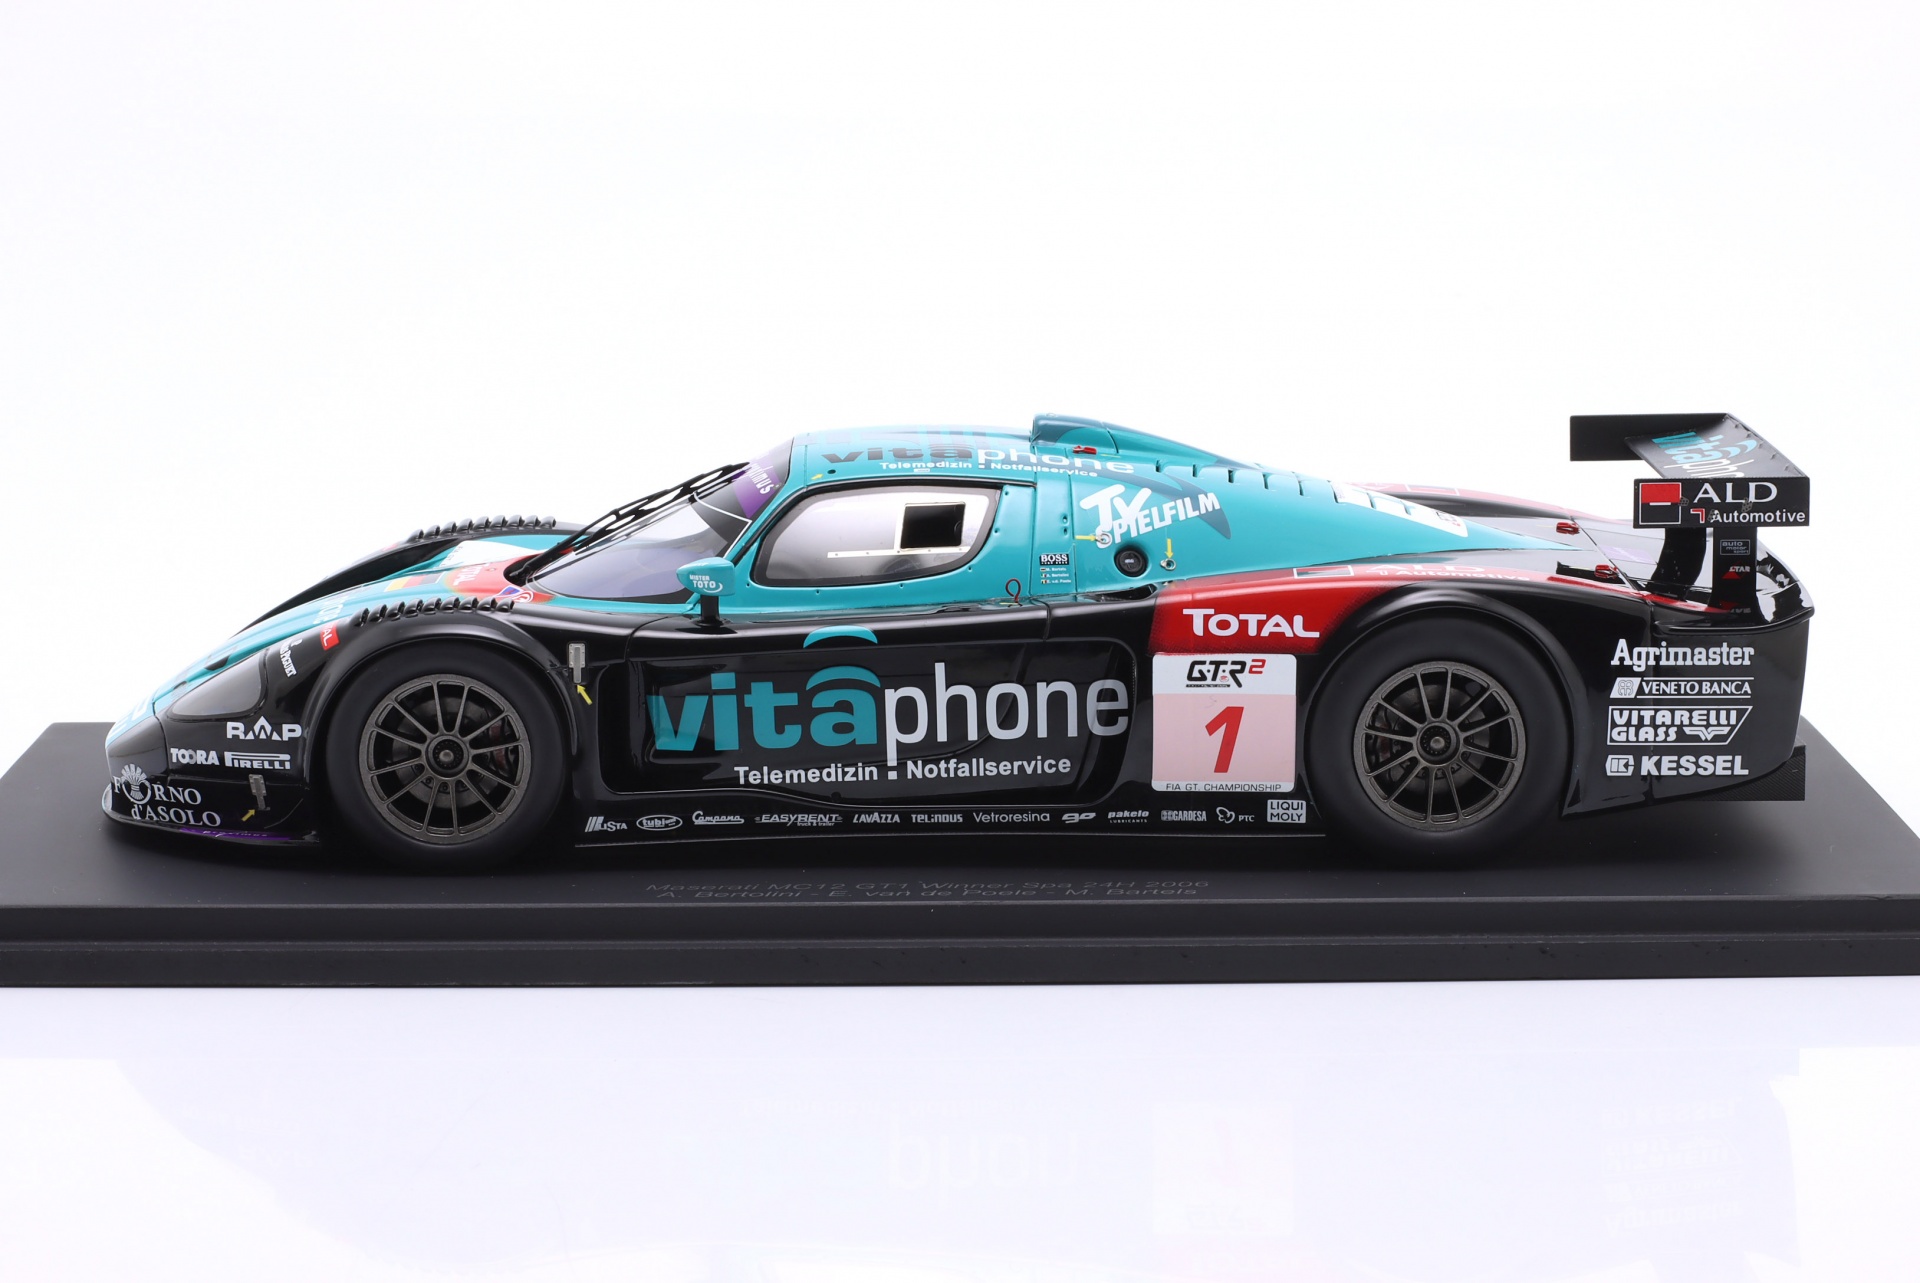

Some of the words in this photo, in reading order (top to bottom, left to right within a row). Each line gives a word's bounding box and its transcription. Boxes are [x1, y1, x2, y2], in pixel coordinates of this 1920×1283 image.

[821, 446, 1134, 474] vitaphone
[879, 461, 972, 470] Telemedizin
[990, 462, 1098, 477] Notfallservice
[1693, 481, 1777, 503] ALD
[1712, 508, 1806, 523] Automotive
[1041, 554, 1068, 562] BOSS
[693, 580, 716, 588] TOTO
[1182, 608, 1320, 638] TOTAL
[1610, 638, 1755, 672] Agrimaster
[1641, 681, 1699, 694] VENETO
[1701, 681, 1752, 694] BANCA
[646, 662, 1129, 767] vitaphone
[1612, 709, 1737, 725] VITARELLI
[1205, 706, 1245, 773] 1
[1611, 726, 1678, 742] GLASS
[170, 748, 219, 766] TOORA
[223, 751, 291, 769] PIRELLI
[734, 763, 878, 785] Telemedizin
[906, 755, 1071, 779] Notfallservice
[1640, 755, 1749, 776] KESSEL
[1165, 783, 1181, 791] FIA
[1203, 783, 1282, 791] CHAMPIONSHIP
[1270, 800, 1303, 811] LIQUI
[131, 804, 222, 827] d'ASOLO
[760, 814, 840, 826] EASYRENT
[852, 812, 900, 823] LAVAZZA
[973, 811, 1050, 823] Vetroresina
[1107, 810, 1149, 819] pakelo
[1173, 810, 1207, 821] GARDESA
[1270, 812, 1303, 822] MOLY
[645, 883, 760, 891] Maserati
[767, 882, 847, 890] MC12
[856, 882, 908, 890] GT1
[1022, 881, 1072, 890] Spa
[694, 890, 802, 898] Bertolini
[920, 889, 952, 897] de
[1106, 888, 1197, 896] Bartels
